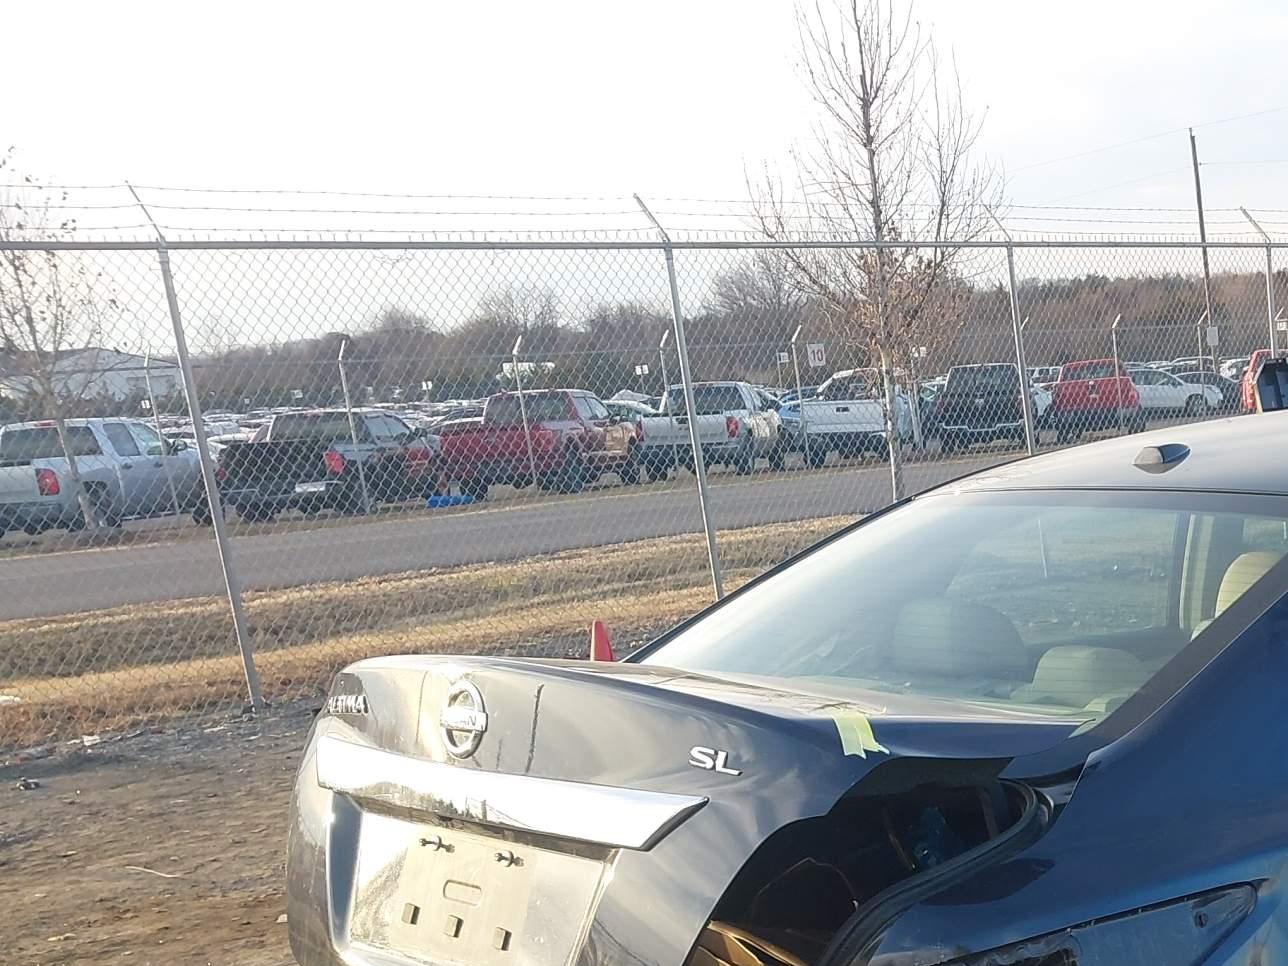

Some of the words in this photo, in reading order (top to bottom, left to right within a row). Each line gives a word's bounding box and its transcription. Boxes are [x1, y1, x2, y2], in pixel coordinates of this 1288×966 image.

[810, 349, 824, 362] 10
[328, 694, 369, 716] ALTIMA
[688, 746, 743, 776] SL
